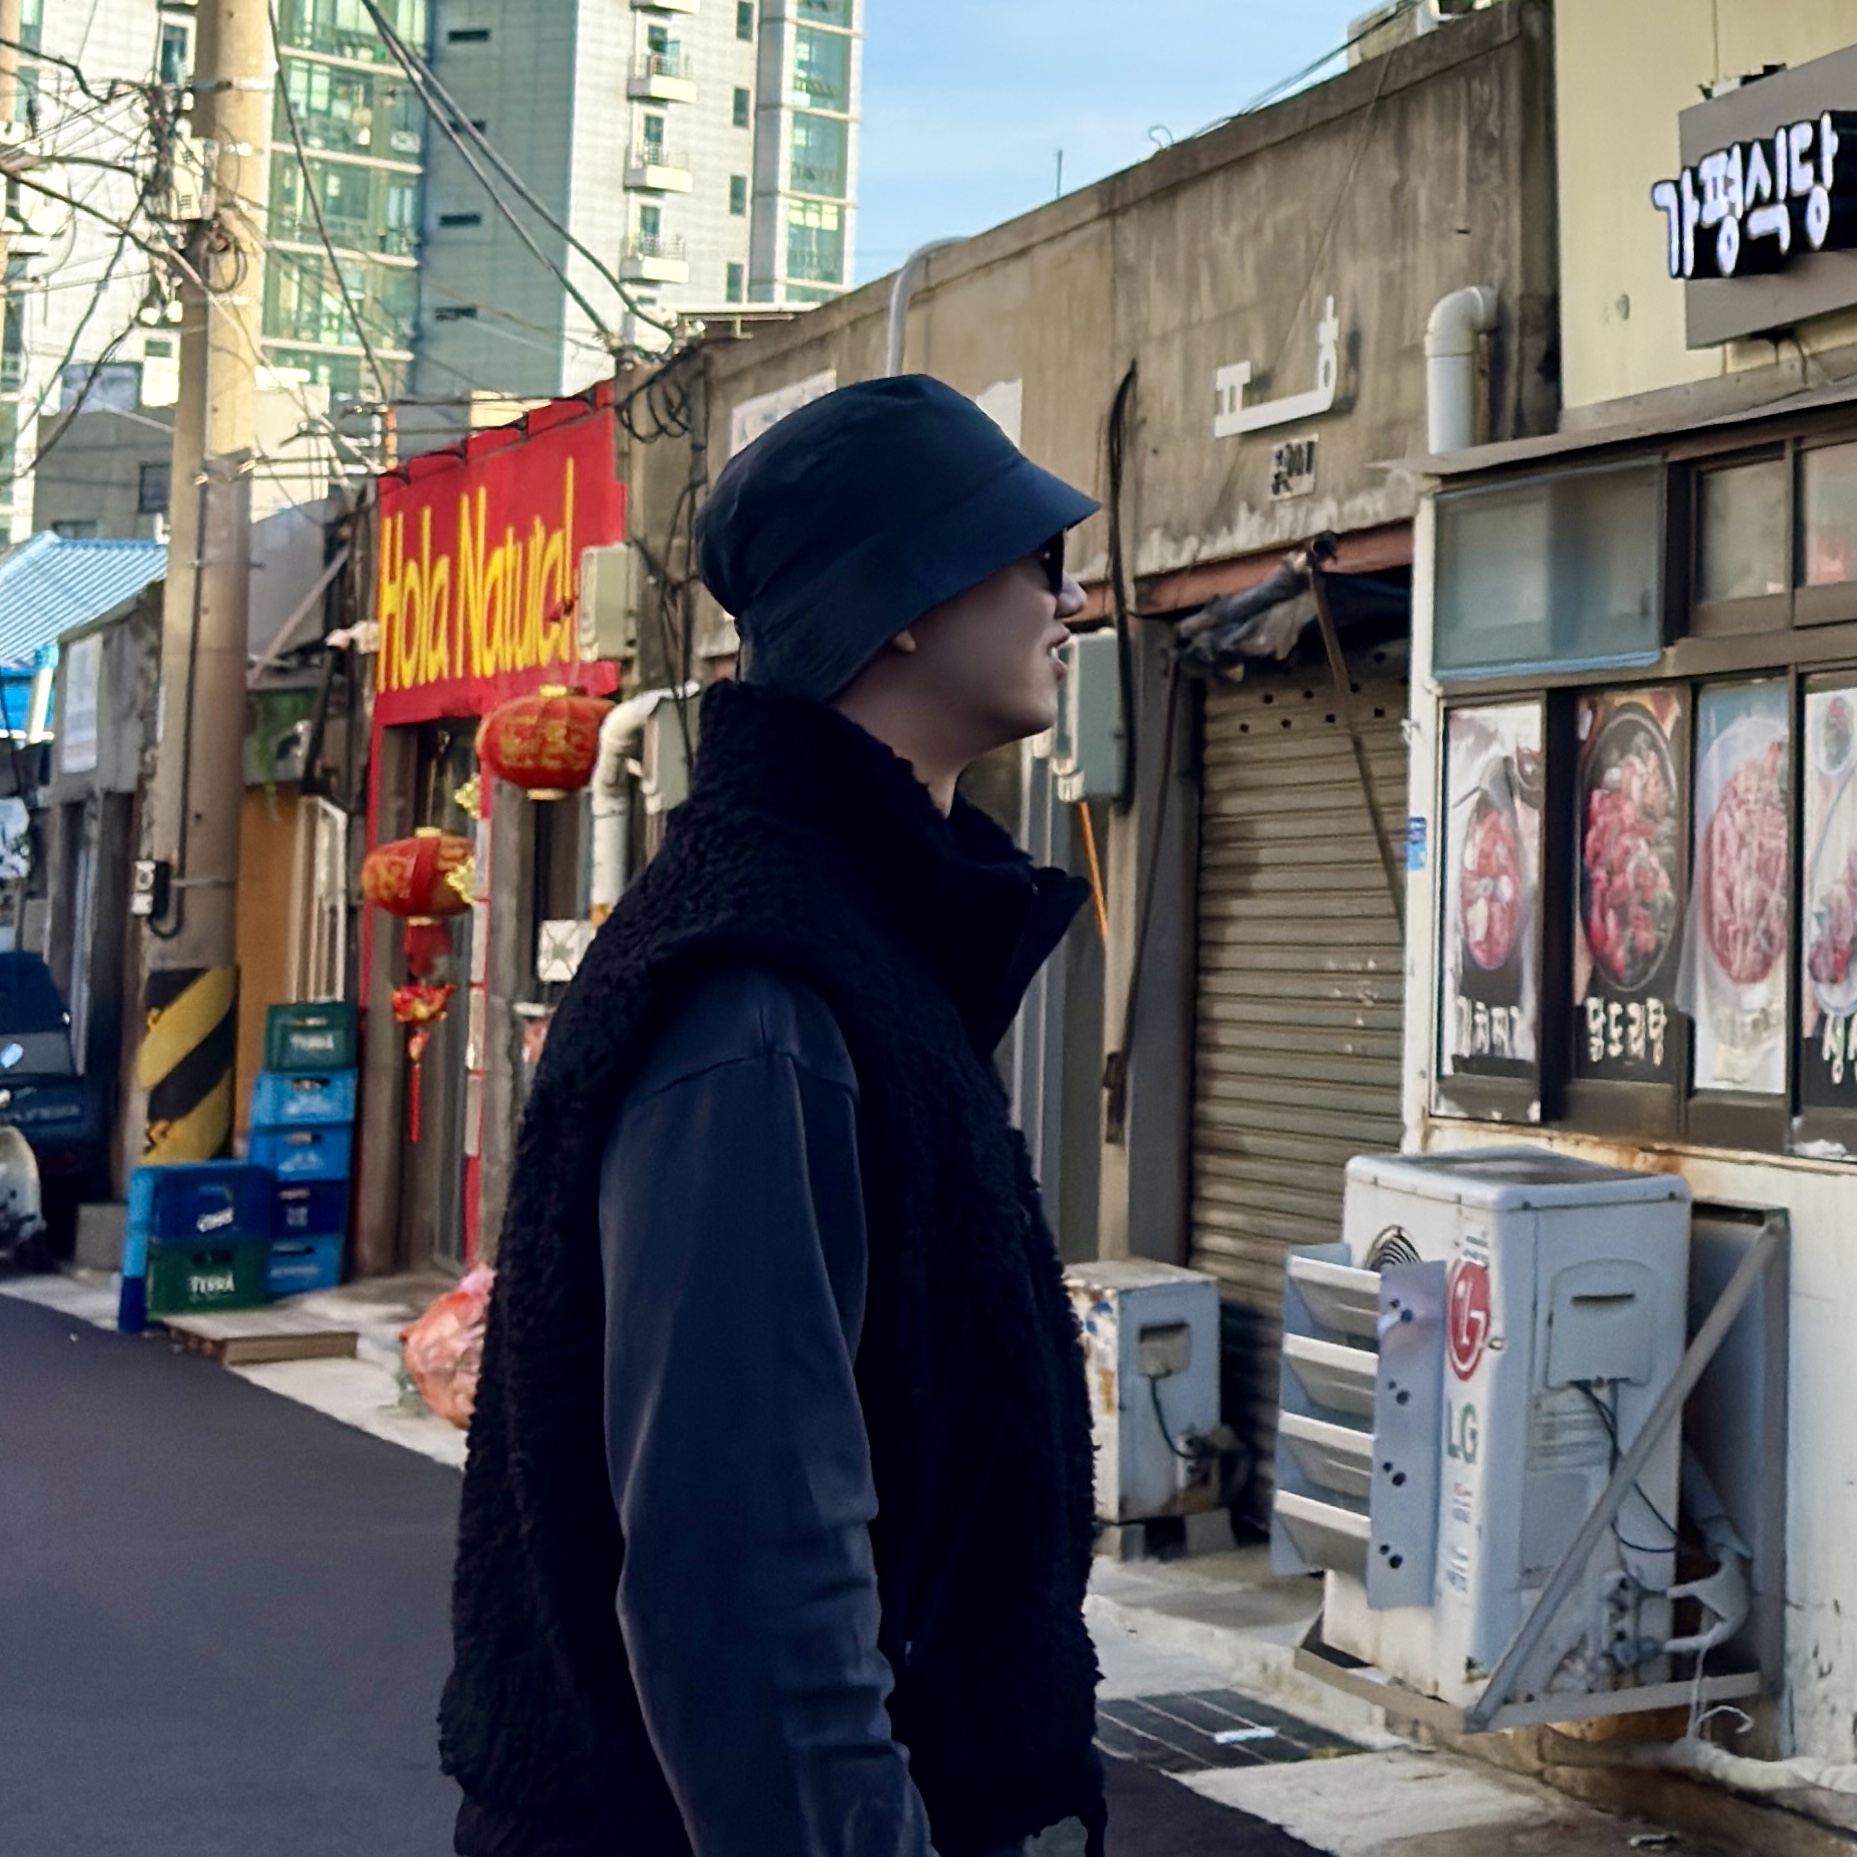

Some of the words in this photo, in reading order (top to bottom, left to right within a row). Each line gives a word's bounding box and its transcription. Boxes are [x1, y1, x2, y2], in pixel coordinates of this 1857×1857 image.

[1653, 110, 1839, 278] 가평식당
[378, 505, 450, 693] Hola
[456, 455, 574, 678] Natural
